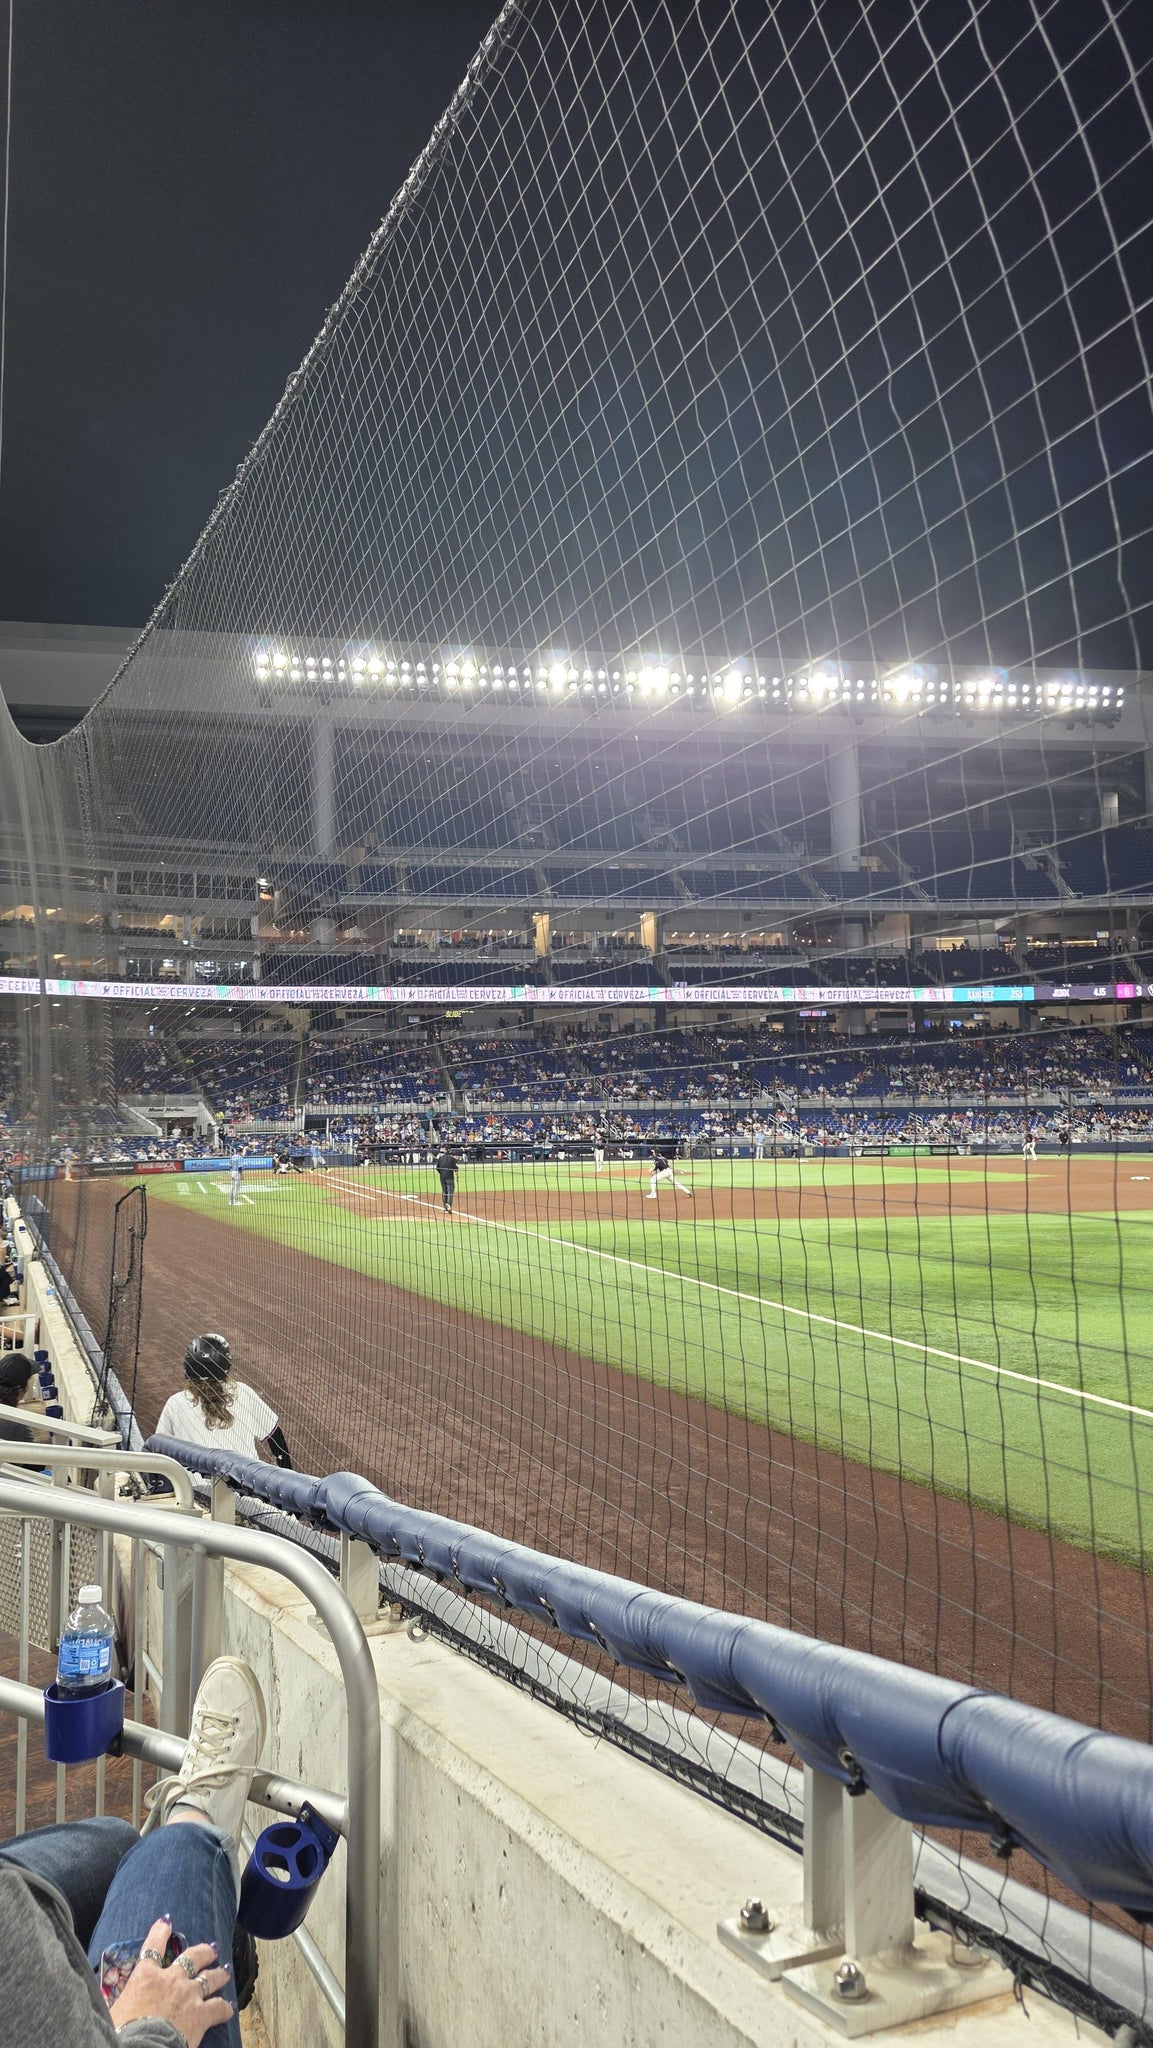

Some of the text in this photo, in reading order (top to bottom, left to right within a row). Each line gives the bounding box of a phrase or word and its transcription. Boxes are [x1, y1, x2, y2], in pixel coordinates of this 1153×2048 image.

[9, 981, 52, 992] CERVEA
[113, 985, 156, 997] OFFICIAL
[170, 987, 213, 998] CERVEZA
[269, 989, 311, 999] OFFICIAL
[323, 989, 364, 1000] CERVEZA
[418, 990, 457, 1000] OFFICIAL
[469, 990, 507, 1000] CERVEZA
[558, 990, 597, 1000] OFFICIAL
[608, 990, 645, 1000] CERVEZA
[694, 990, 729, 1000] OFFICIAL
[743, 990, 780, 1000] CERVEZA
[827, 990, 862, 1000] OFFICIAL
[875, 990, 911, 1000] CERVEZA
